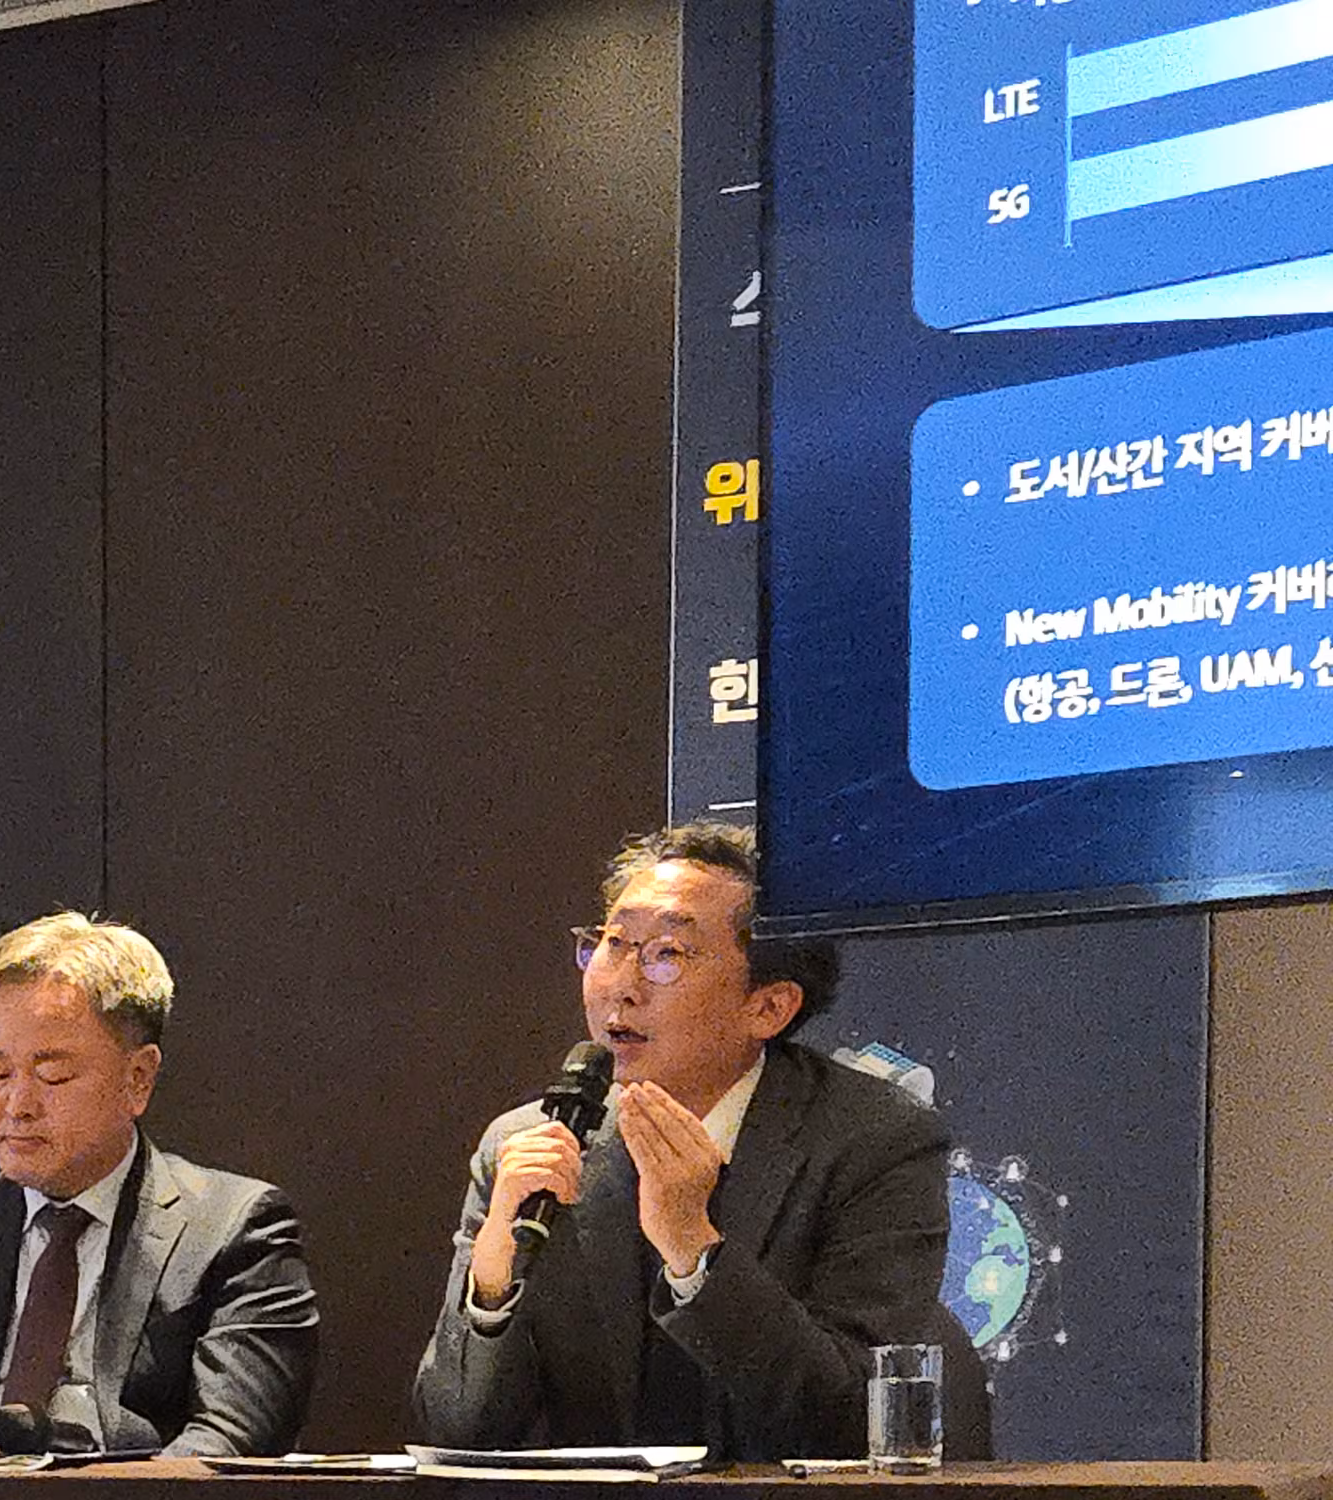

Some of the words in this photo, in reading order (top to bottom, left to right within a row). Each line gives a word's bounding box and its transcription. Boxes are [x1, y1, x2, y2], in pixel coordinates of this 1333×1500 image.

[983, 78, 1041, 124] LTE
[986, 183, 1031, 225] 5G
[1004, 434, 1169, 504] 도서/산간
[1173, 418, 1253, 476] 지역
[1004, 606, 1087, 648] New
[1093, 580, 1242, 636] Mobility
[1245, 556, 1333, 615] 커버
[1105, 655, 1194, 708] 드론,
[1199, 643, 1305, 693] UAM,
